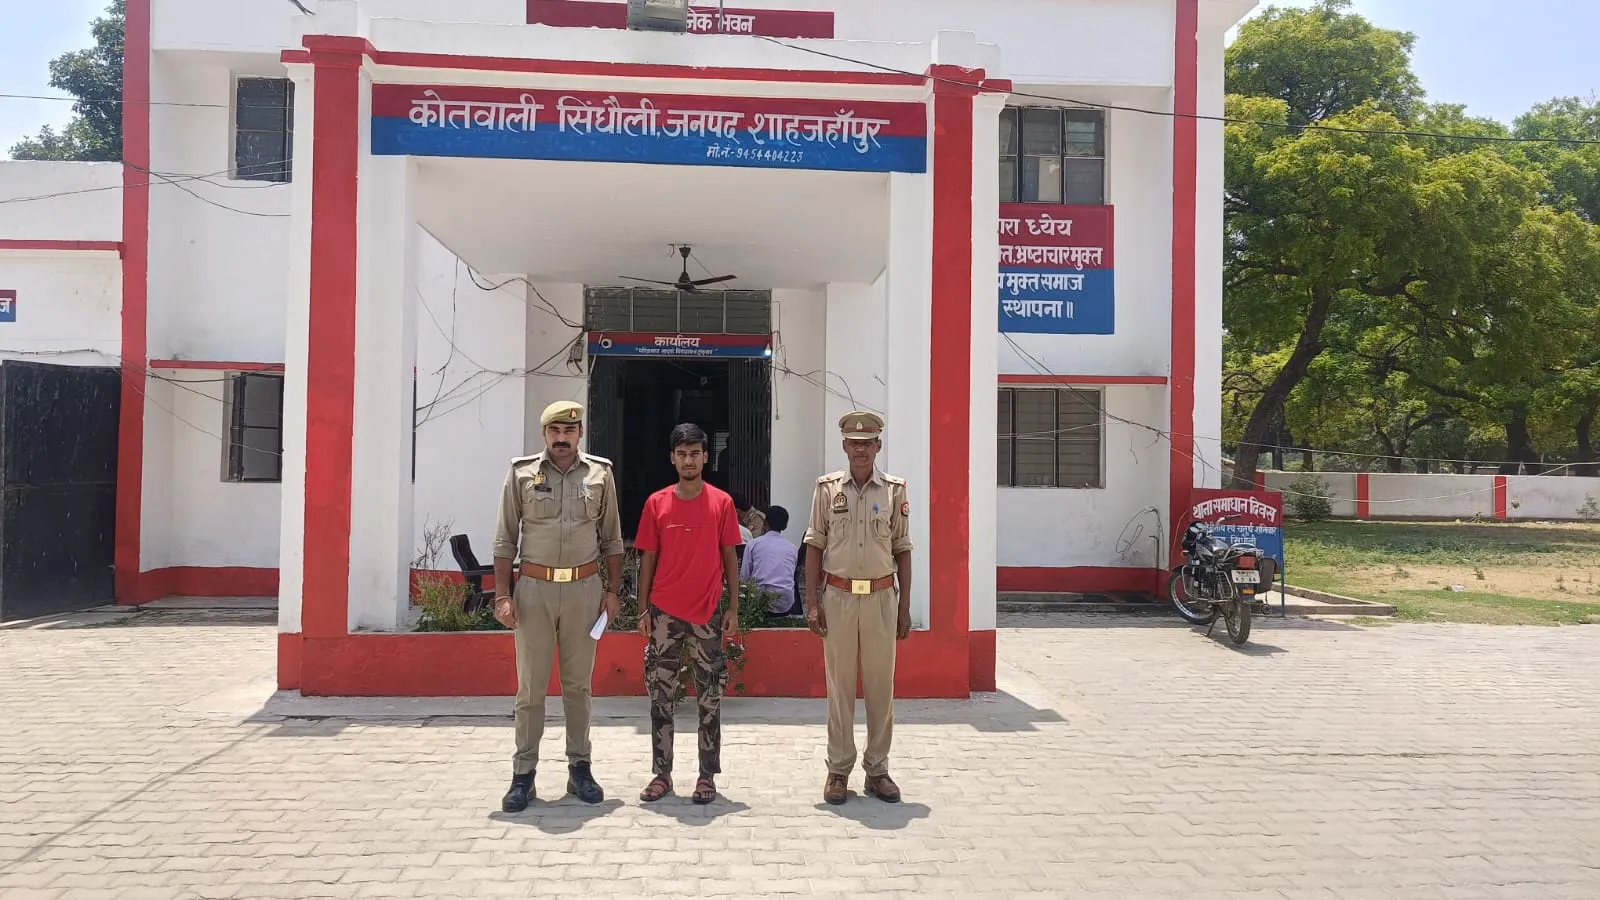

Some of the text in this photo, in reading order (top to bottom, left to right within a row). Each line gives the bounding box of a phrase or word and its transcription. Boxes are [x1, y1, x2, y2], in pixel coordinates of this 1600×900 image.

[408, 89, 545, 132] कोतवाली
[662, 109, 745, 144] जनपद
[748, 107, 891, 153] शाहजहाँपुर
[1025, 213, 1073, 236] ध्येय
[1006, 273, 1041, 295] मुक्त
[1041, 273, 1085, 291] समाज
[654, 335, 702, 348] कार्यालय
[1212, 497, 1249, 513] समाधान
[1249, 496, 1278, 522] दिवस
